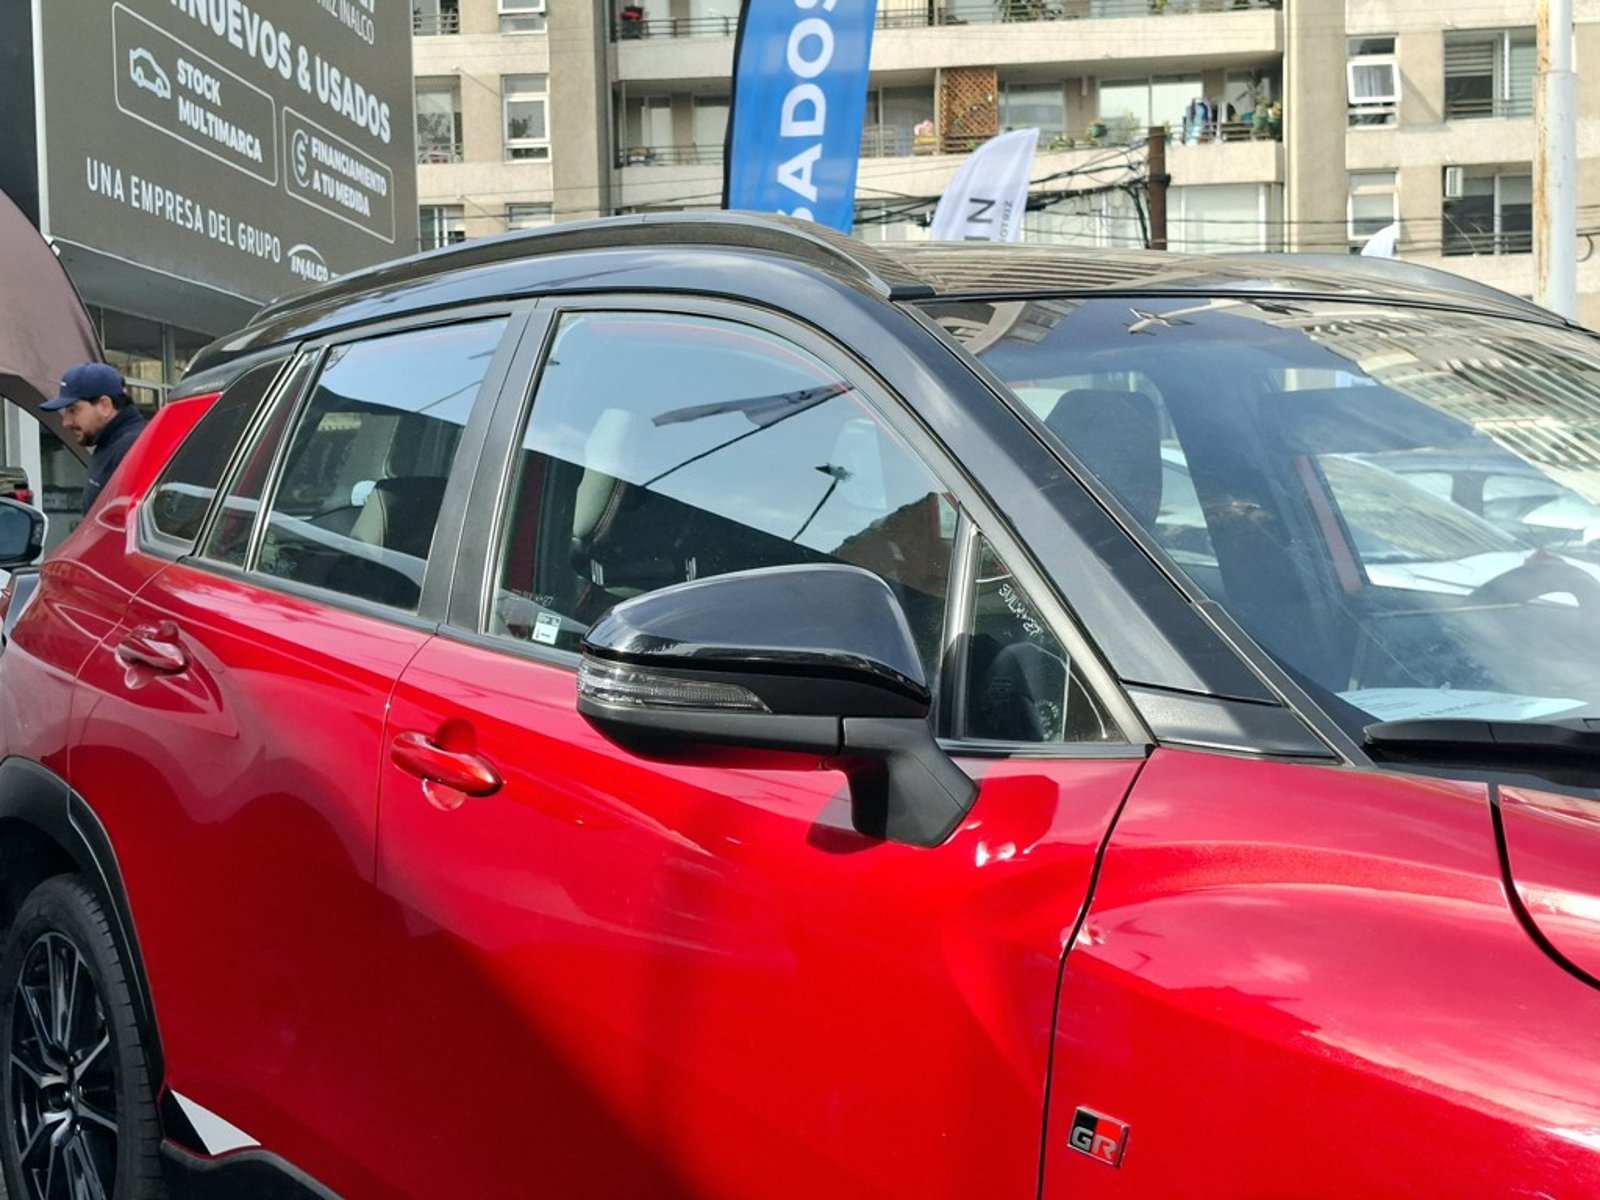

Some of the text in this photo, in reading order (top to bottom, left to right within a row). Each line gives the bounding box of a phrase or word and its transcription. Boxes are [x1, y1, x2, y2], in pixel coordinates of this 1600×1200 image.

[177, 58, 222, 107] STOCK
[298, 45, 312, 94] &
[315, 54, 391, 144] USADOS
[777, 0, 837, 222] ADO
[178, 96, 263, 163] MULTIMARCA
[311, 136, 387, 196] FINANCIAMIENTO
[313, 169, 370, 217] A TU MEDIDA
[87, 157, 125, 202] UNA
[130, 175, 204, 234] EMPRESA
[208, 209, 235, 246] DEL
[238, 223, 281, 263] GRUPO
[1071, 1126, 1117, 1160] GR
